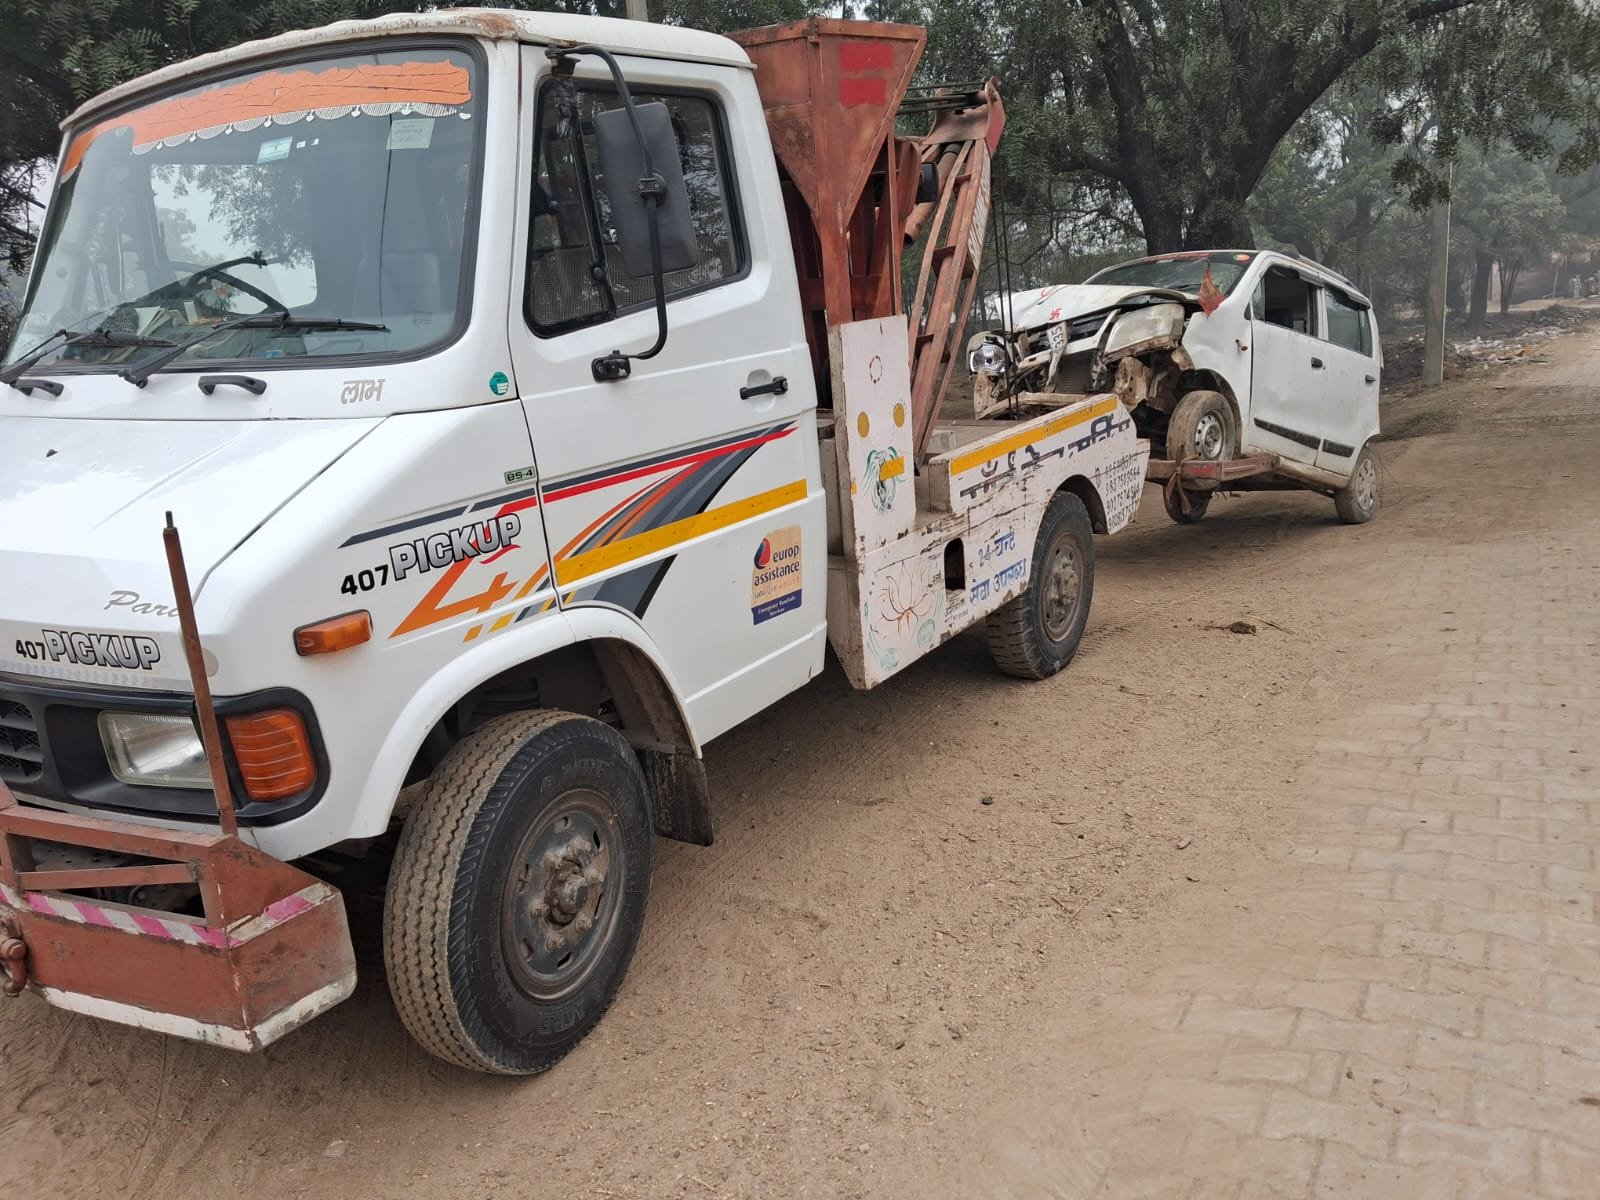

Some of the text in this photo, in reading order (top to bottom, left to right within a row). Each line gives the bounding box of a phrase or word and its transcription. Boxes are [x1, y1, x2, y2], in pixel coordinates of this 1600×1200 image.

[341, 379, 386, 404] लाभ
[506, 468, 534, 483] BS-4
[340, 513, 521, 595] 407 PICKUP
[773, 545, 800, 562] europ
[754, 561, 800, 587] assistance
[15, 629, 160, 670] 407 PICKUP
